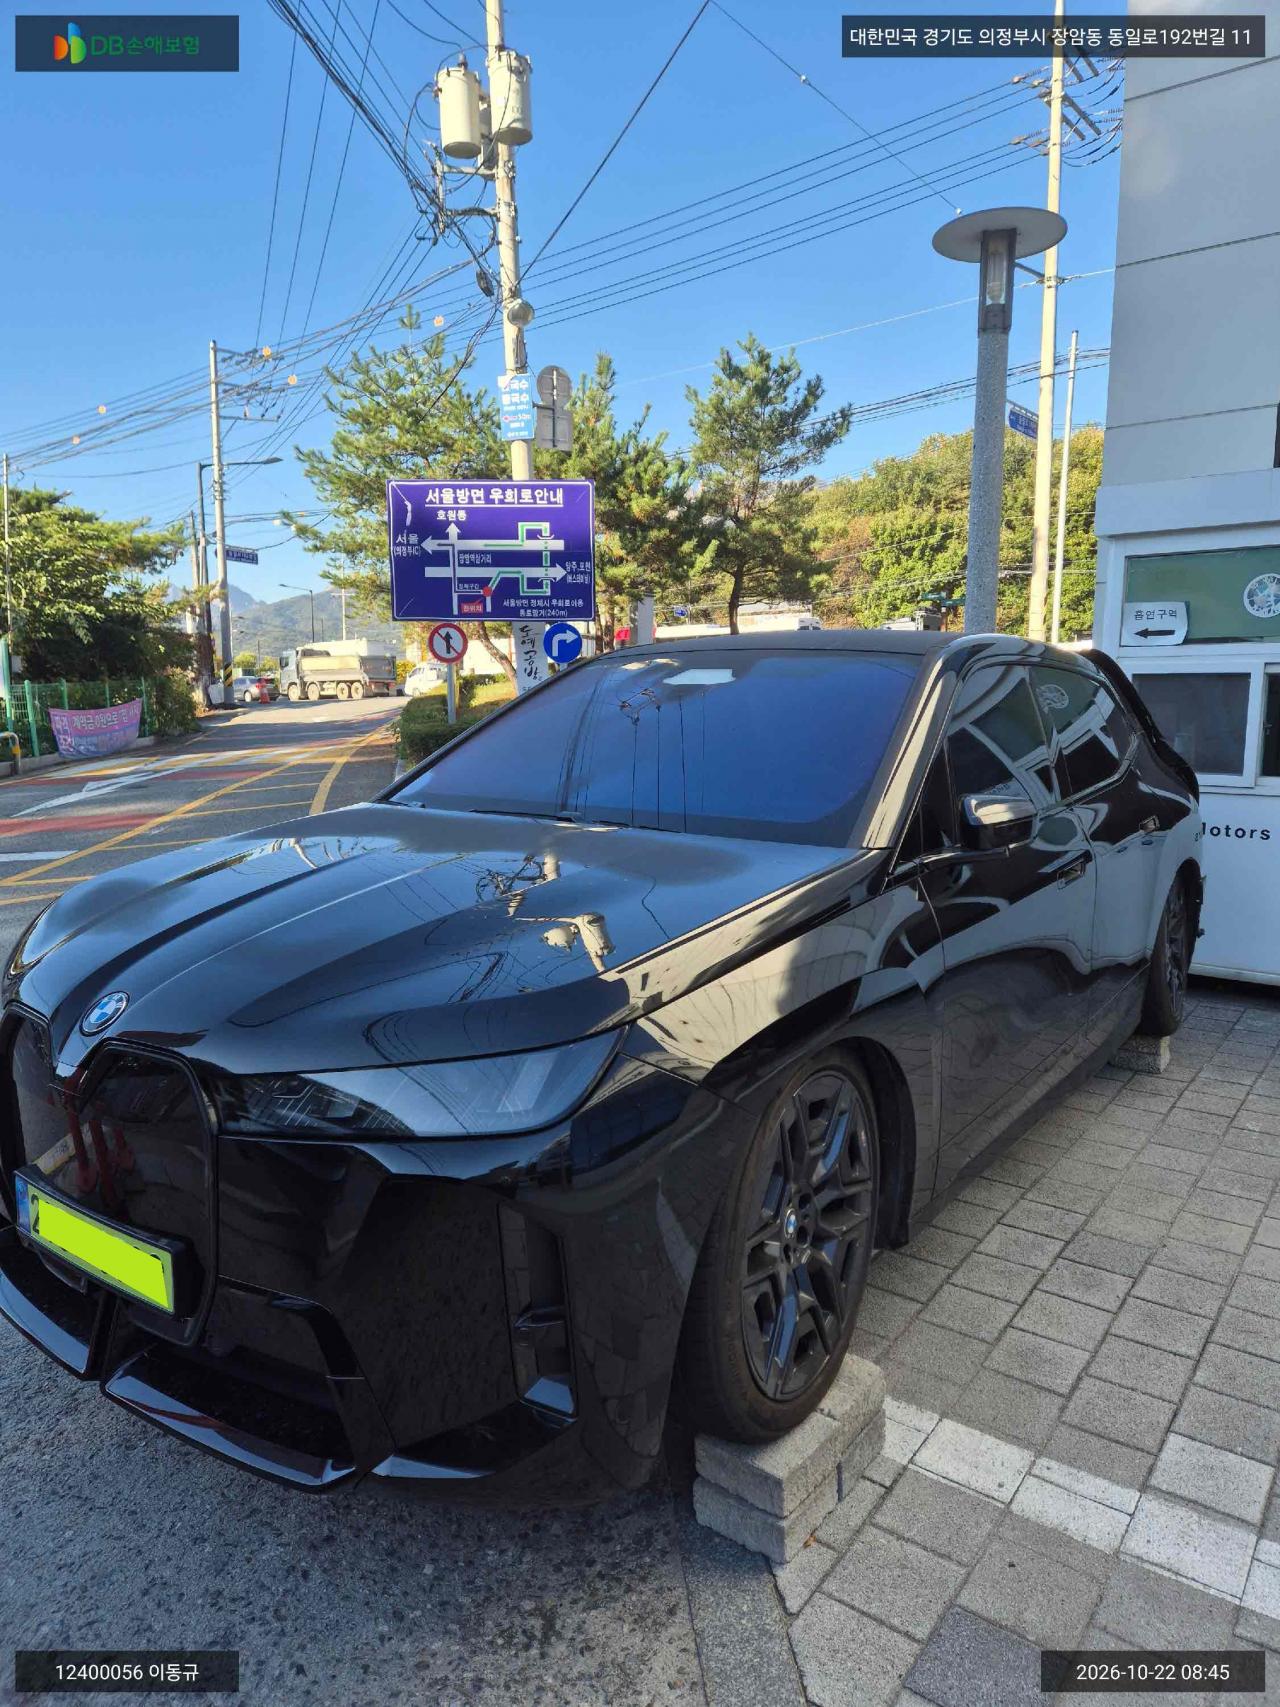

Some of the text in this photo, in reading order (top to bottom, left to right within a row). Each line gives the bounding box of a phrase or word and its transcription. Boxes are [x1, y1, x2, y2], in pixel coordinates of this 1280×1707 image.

[425, 487, 564, 505] 서울방면 우회로안내
[436, 509, 467, 521] 호원동
[395, 532, 419, 545] 서울
[1134, 609, 1177, 621] 흡연구역
